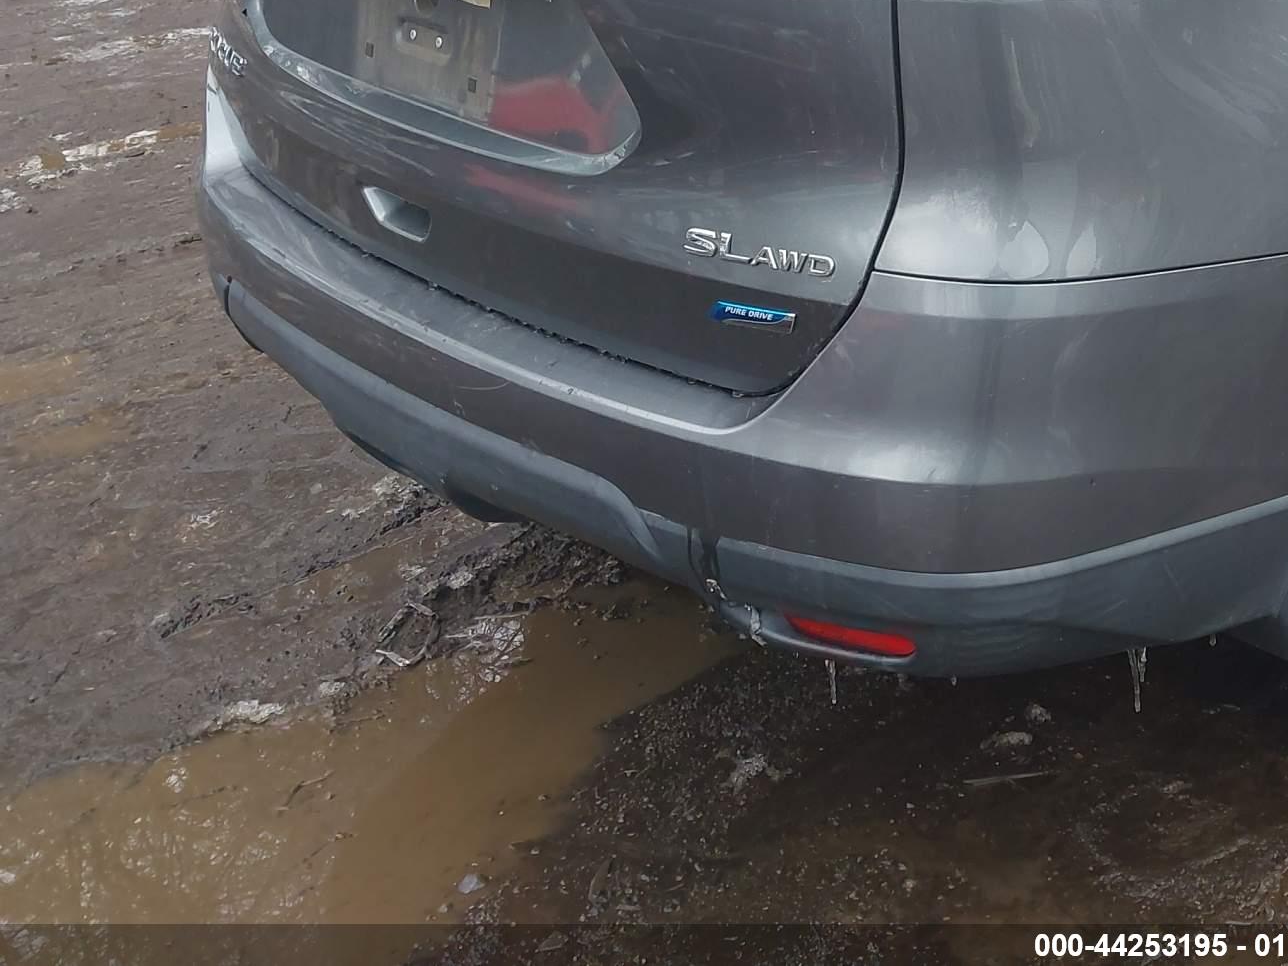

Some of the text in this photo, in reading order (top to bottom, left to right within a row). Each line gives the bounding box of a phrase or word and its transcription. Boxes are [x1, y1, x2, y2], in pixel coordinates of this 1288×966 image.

[750, 245, 837, 278] AWD
[725, 305, 774, 321] PURE DRIVE
